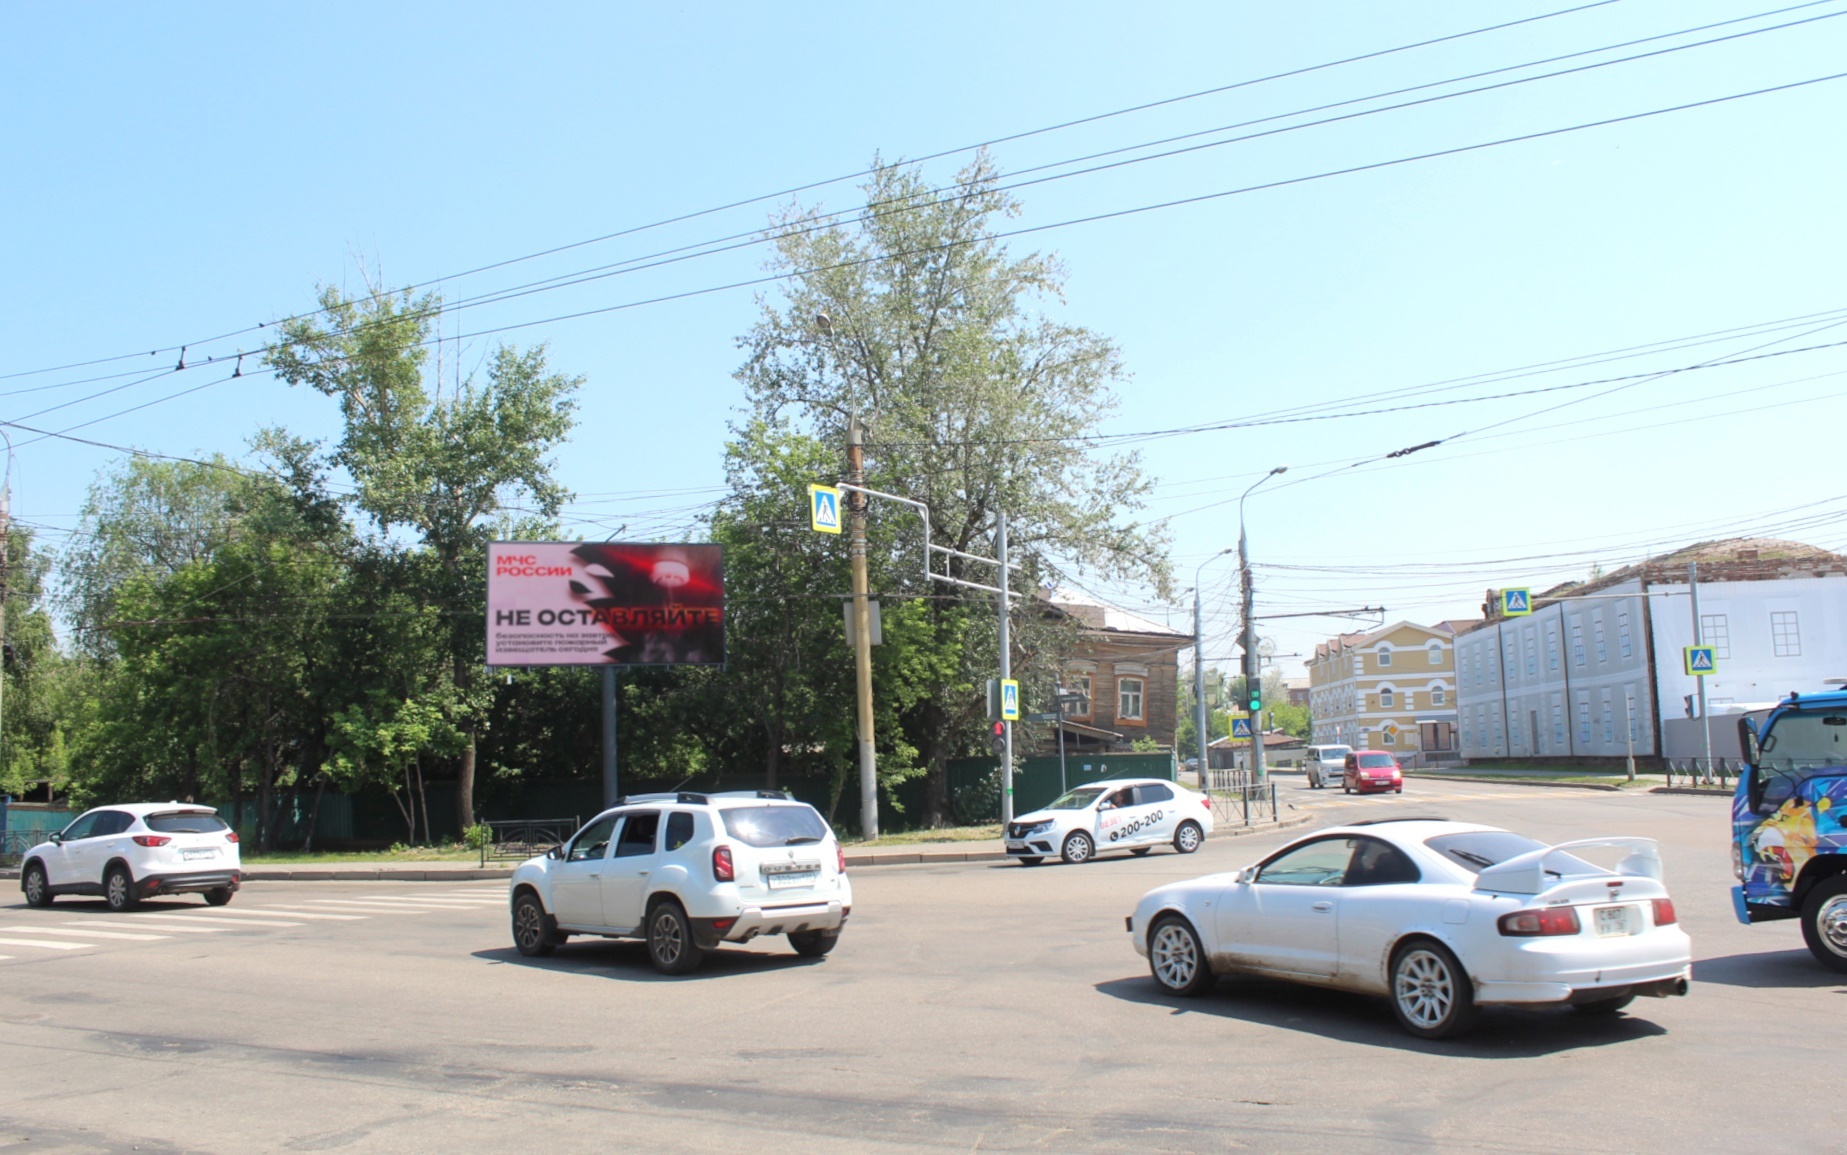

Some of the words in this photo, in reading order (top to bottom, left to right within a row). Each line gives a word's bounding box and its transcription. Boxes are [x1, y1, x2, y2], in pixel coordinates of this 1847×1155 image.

[496, 555, 537, 566] МЧС
[496, 566, 573, 577] РОССИИ
[496, 609, 531, 626] НЕ
[537, 603, 719, 626] ОСТАВЛЯЙТЕ
[495, 632, 565, 640] безопасность
[1121, 810, 1163, 838] 200-200
[764, 864, 820, 872] DUSTER
